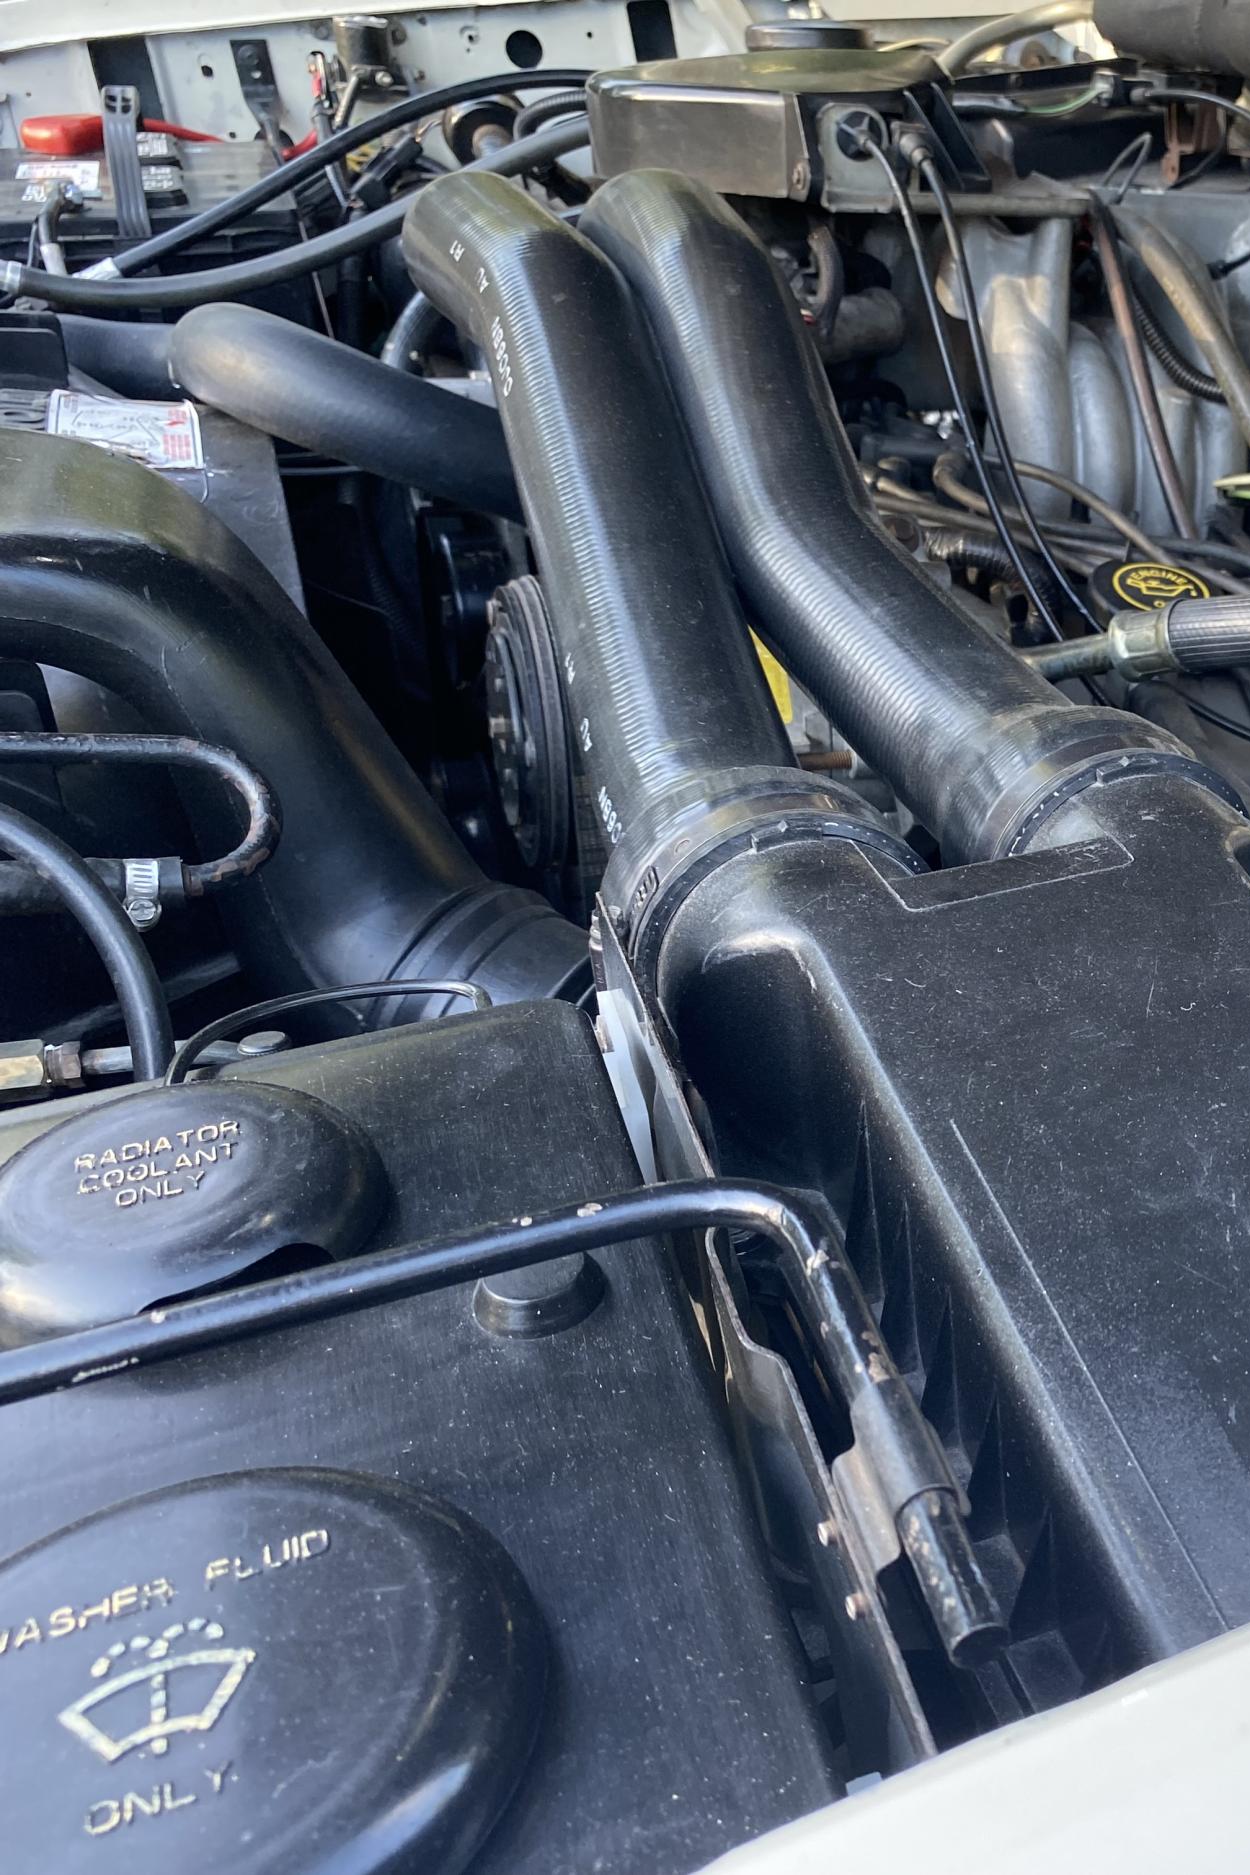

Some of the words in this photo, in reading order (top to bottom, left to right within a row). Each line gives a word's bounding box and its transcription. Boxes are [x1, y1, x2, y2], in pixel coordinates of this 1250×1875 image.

[1130, 569, 1188, 585] ENGINE
[74, 1120, 241, 1172] RADIATOR
[78, 1142, 239, 1195] COOLANT
[115, 1170, 206, 1208] ONLY
[204, 1529, 331, 1590] FLUID
[83, 1760, 234, 1836] ONLY
